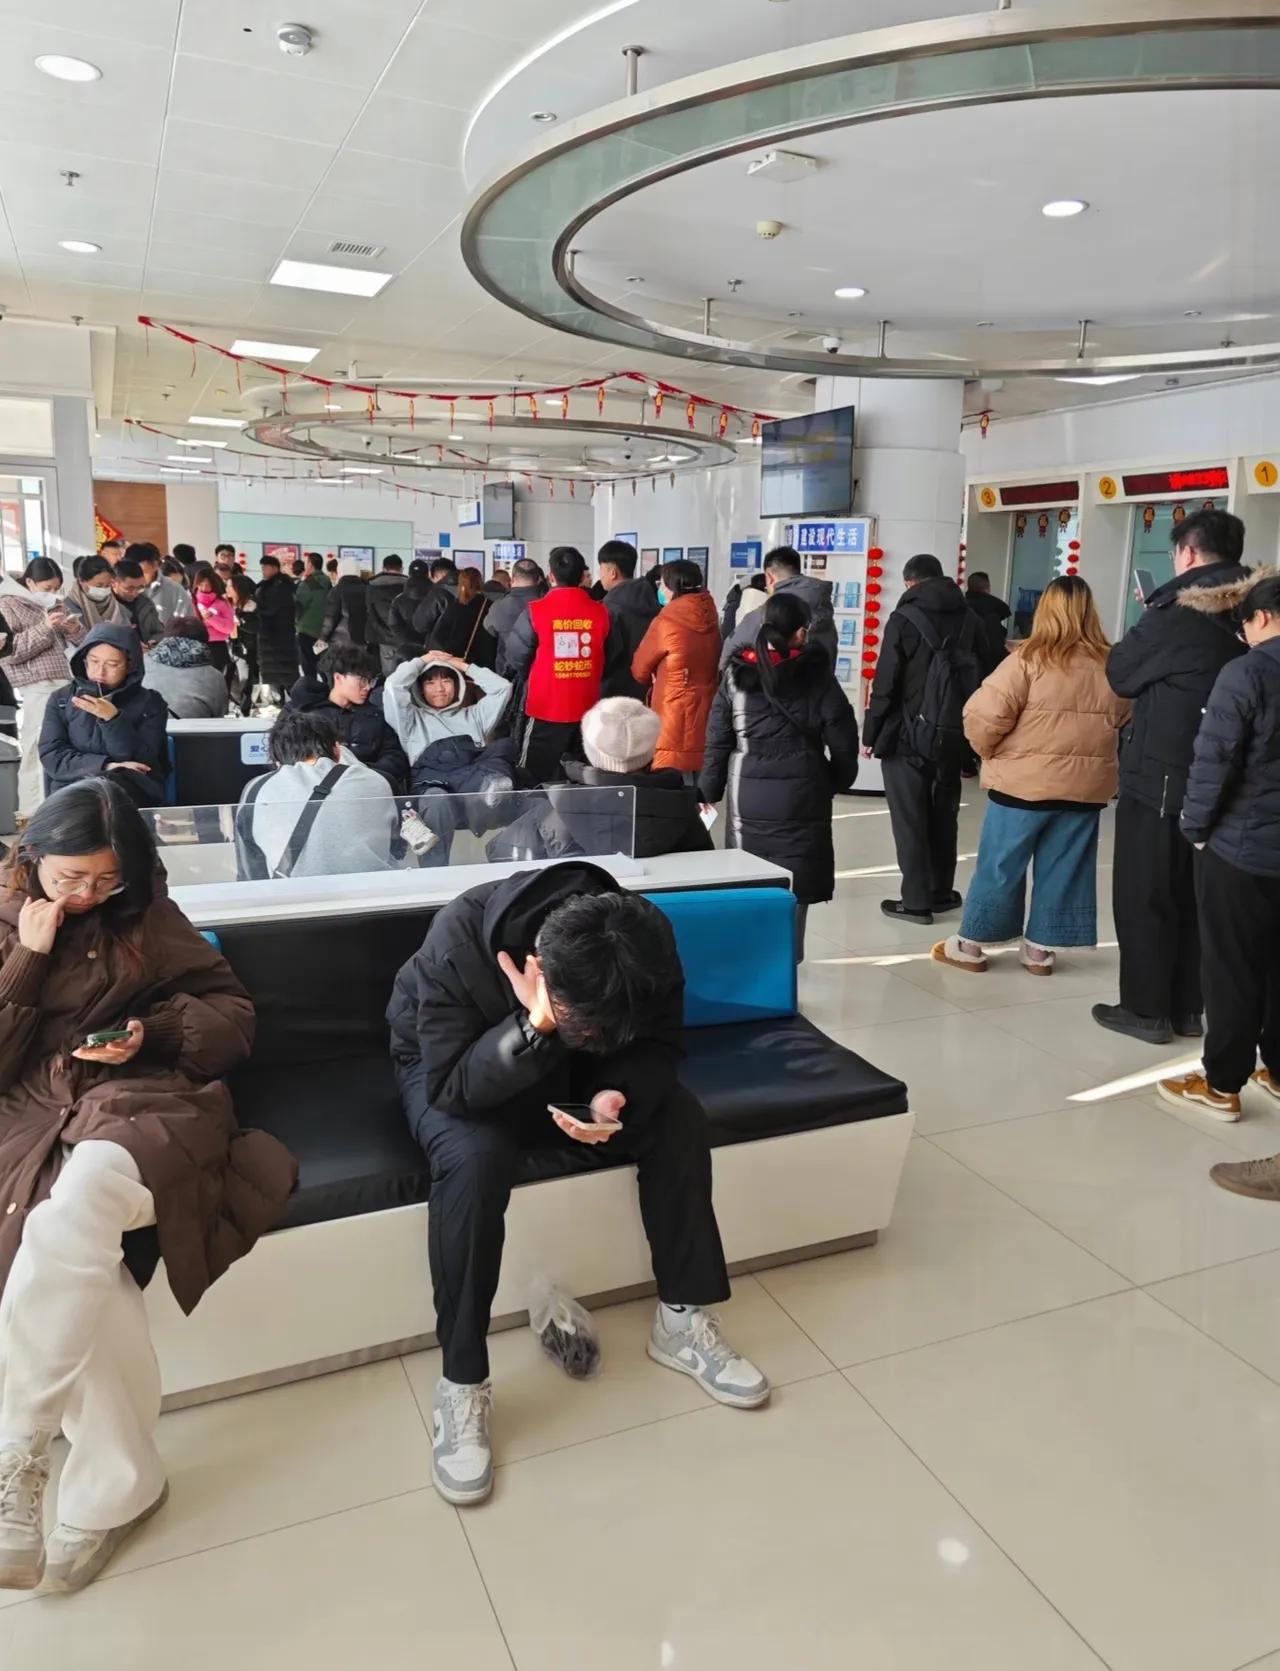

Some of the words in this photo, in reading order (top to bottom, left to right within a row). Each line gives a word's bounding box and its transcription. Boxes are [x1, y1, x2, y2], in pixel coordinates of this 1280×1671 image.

[1261, 466, 1269, 482] 1
[1103, 480, 1113, 495] 2
[983, 491, 993, 505] 3
[800, 527, 858, 546] 建设现代生活
[552, 619, 592, 630] 高价回收
[554, 660, 592, 671] 蛇钞蛇币
